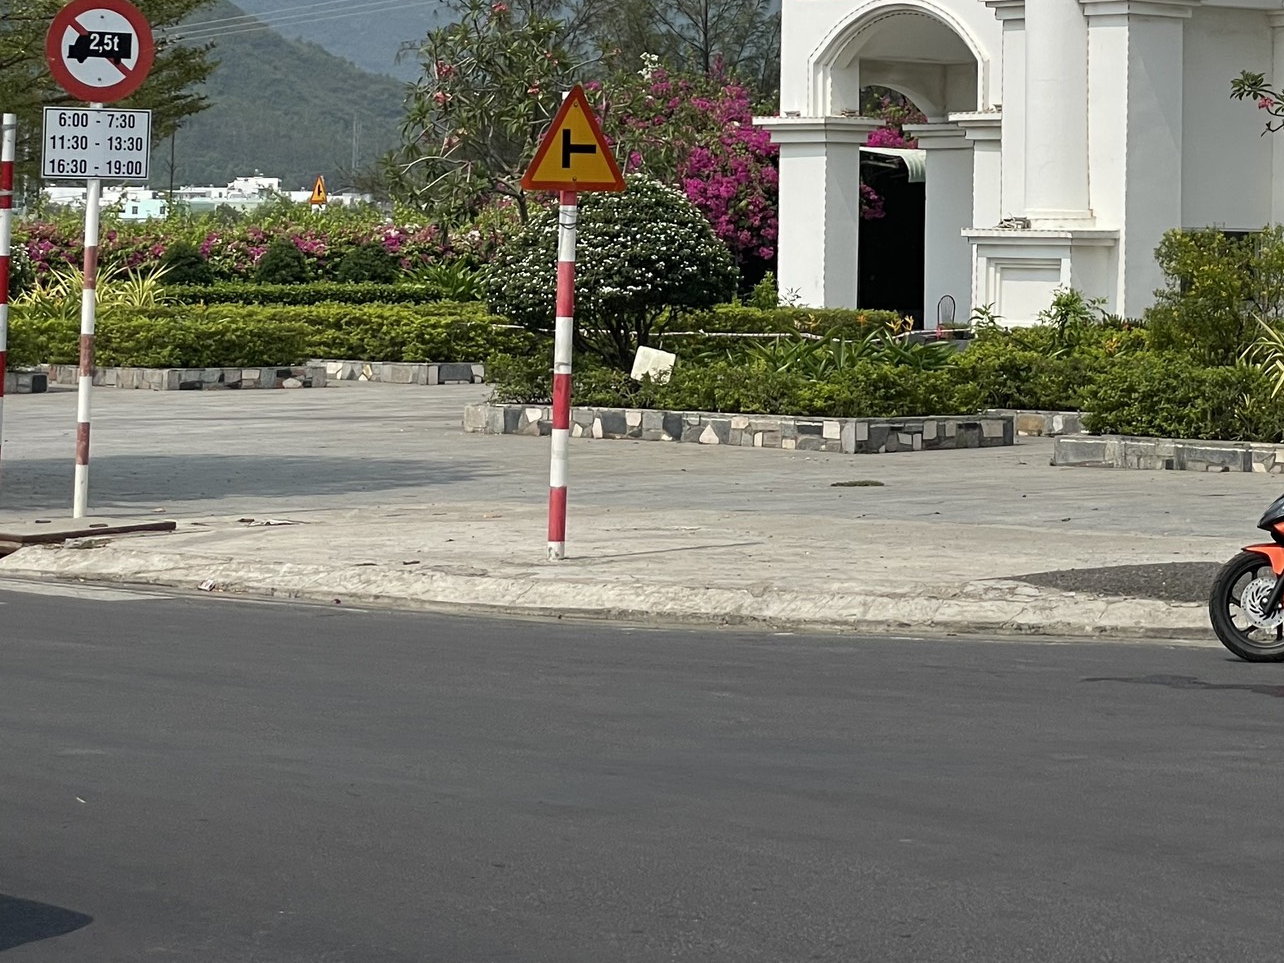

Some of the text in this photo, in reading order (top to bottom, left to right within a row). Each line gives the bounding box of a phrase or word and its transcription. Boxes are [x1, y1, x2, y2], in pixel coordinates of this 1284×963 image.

[89, 33, 119, 53] 2,5t
[58, 112, 89, 128] 6:00
[107, 114, 135, 129] 7:30
[50, 135, 88, 150] 11:30
[107, 137, 143, 152] 13:30
[49, 159, 87, 174] 16:30
[106, 161, 142, 175] 19:00
